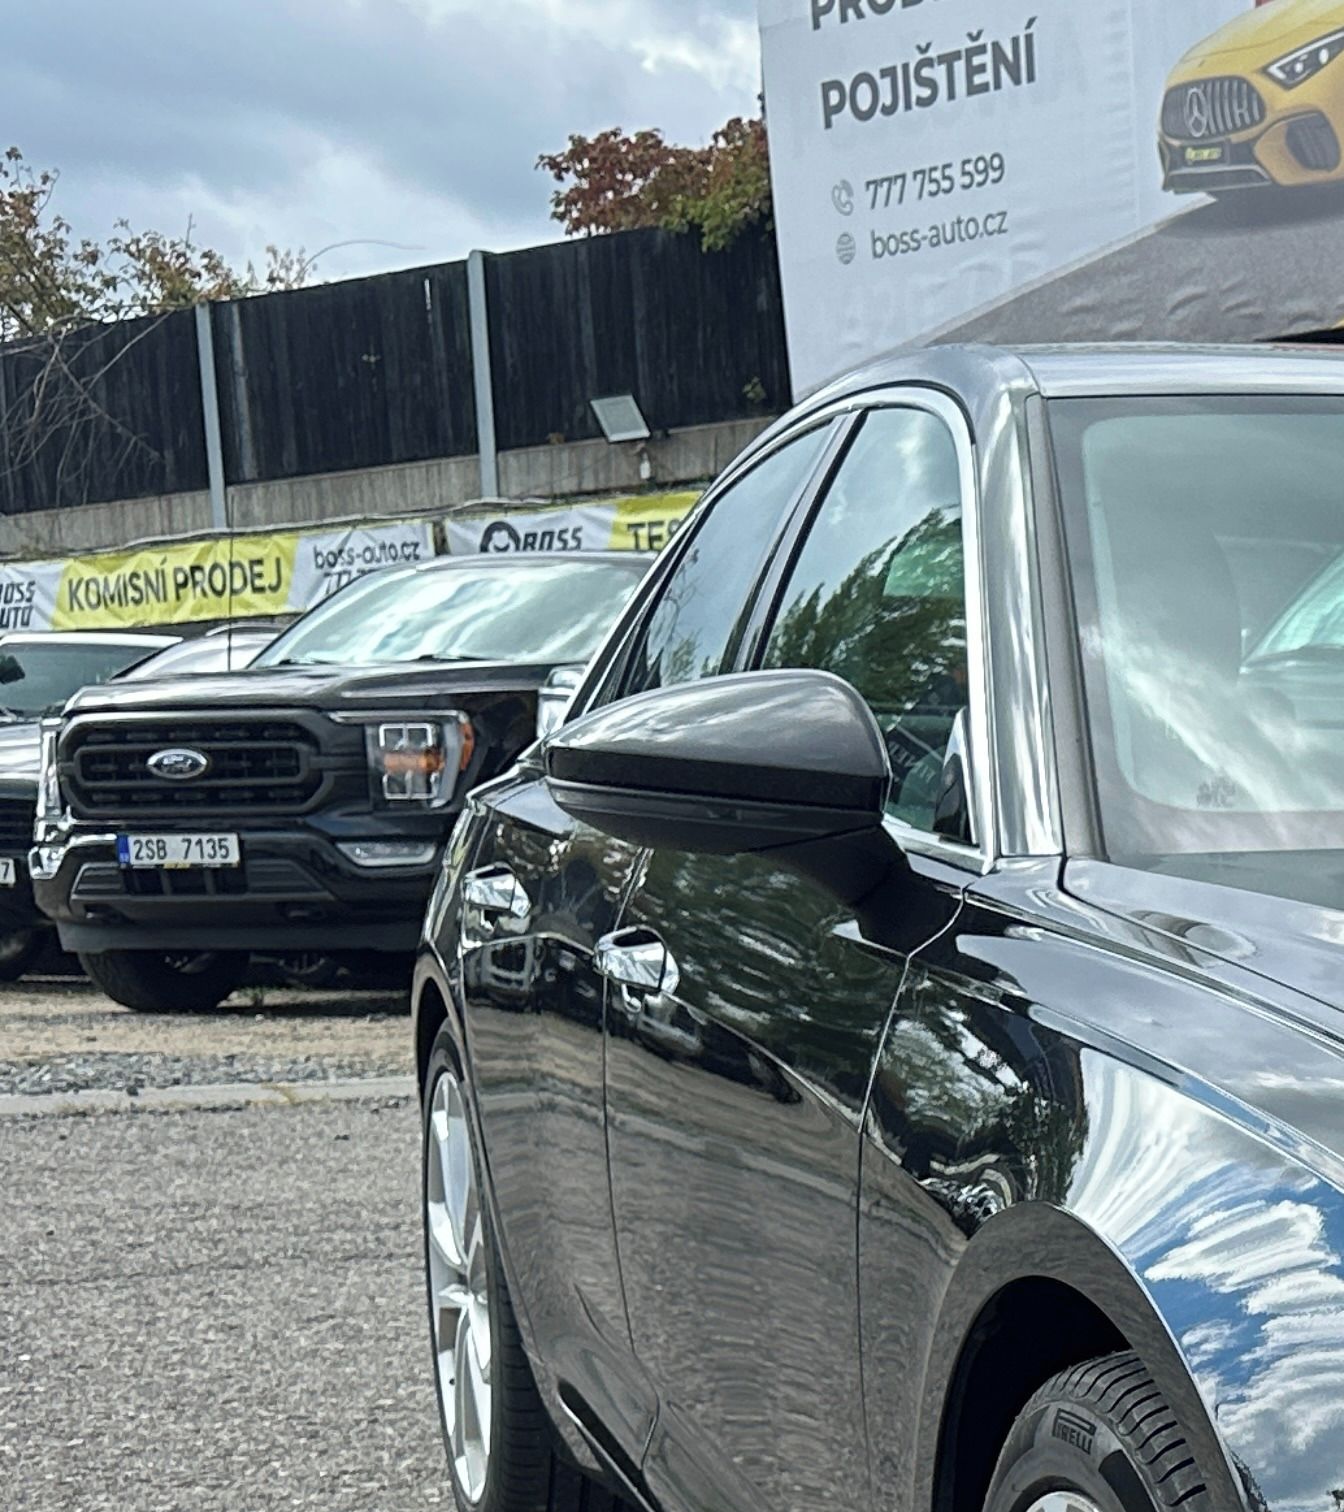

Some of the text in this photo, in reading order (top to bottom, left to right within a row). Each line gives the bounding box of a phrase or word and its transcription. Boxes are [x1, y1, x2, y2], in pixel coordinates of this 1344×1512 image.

[820, 16, 1038, 130] POJIŠTĚNÍ
[865, 152, 1006, 210] 777 755 599
[870, 210, 1009, 260] boss-auto.cz
[0, 580, 36, 604] OSS
[68, 556, 282, 612] KOMISNÍ PRODEJ
[0, 605, 35, 629] UTO
[133, 837, 230, 861] 2SB 7135
[1052, 1408, 1097, 1455] PIRELLI
